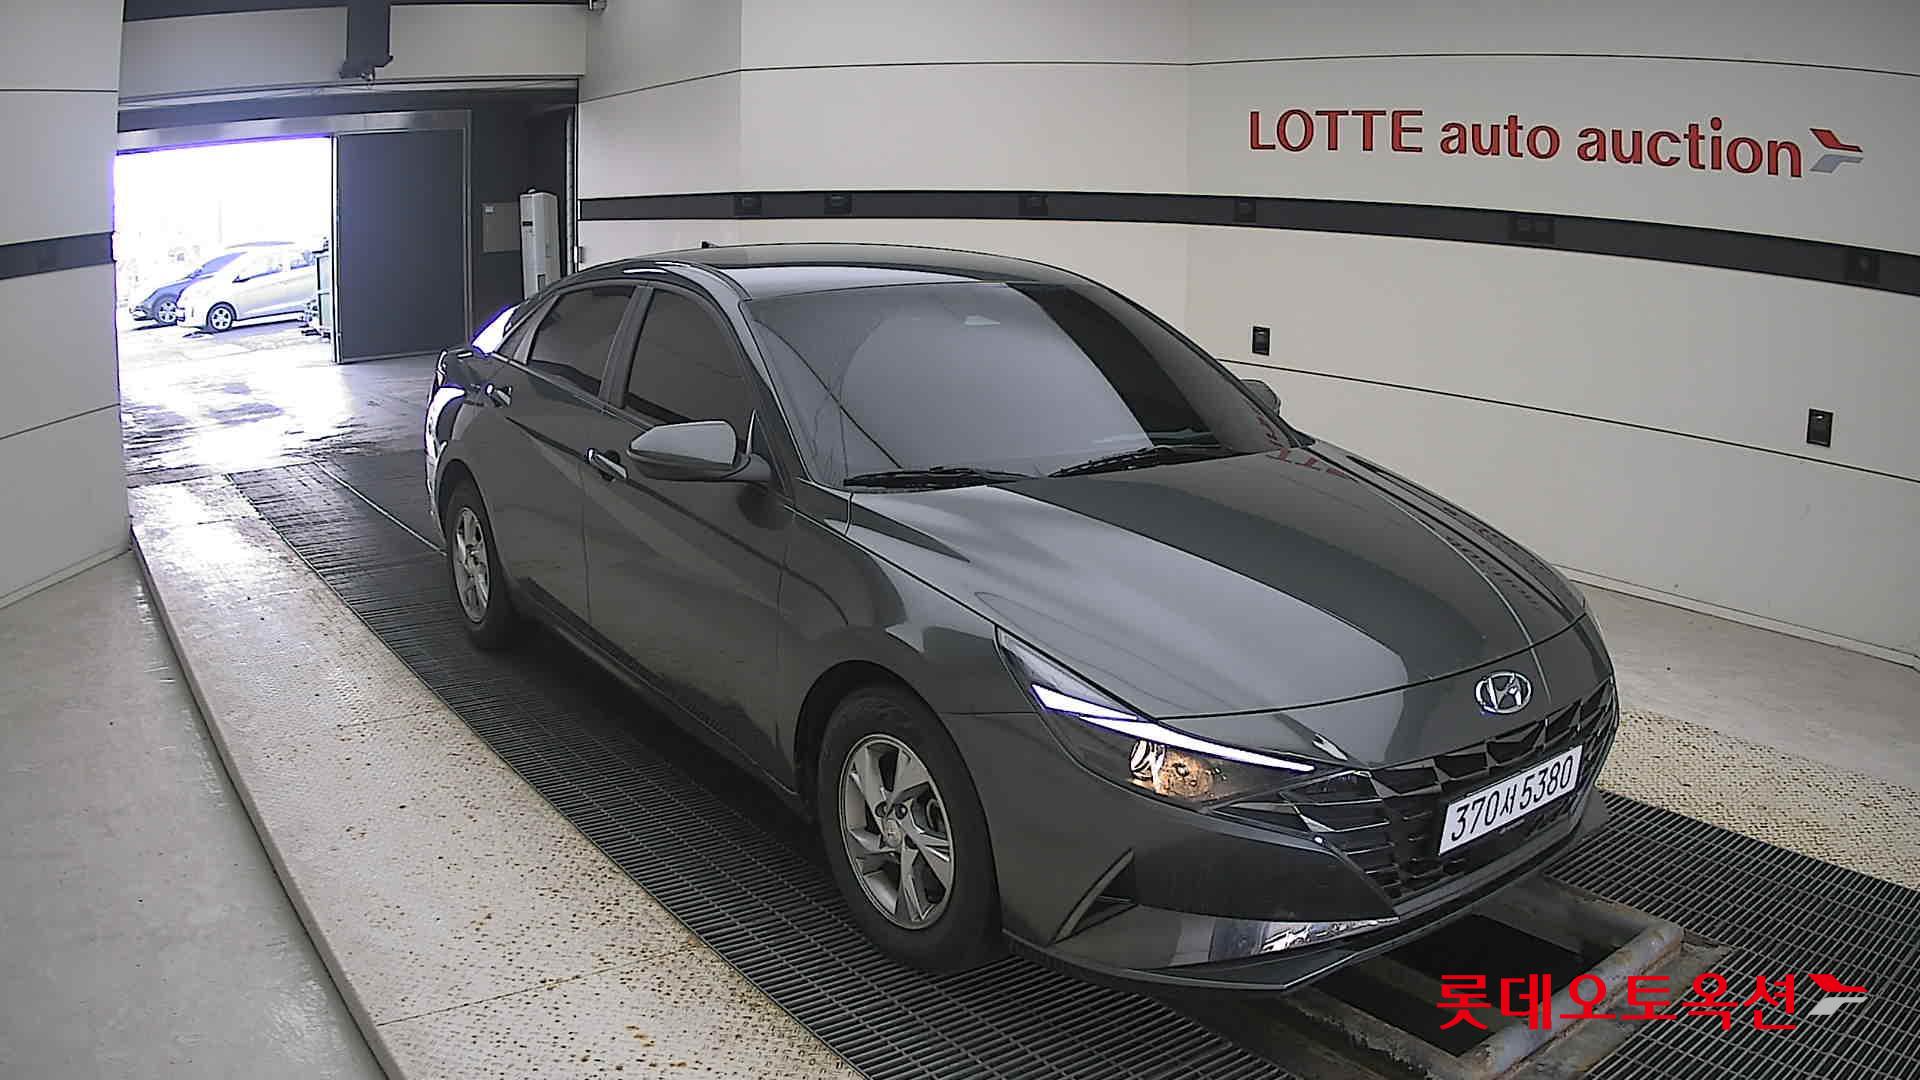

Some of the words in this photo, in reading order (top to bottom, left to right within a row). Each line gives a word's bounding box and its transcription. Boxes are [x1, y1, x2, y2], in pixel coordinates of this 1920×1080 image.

[1249, 110, 1423, 152] LOTTE
[1441, 115, 1560, 160] auto
[1577, 117, 1803, 177] auction
